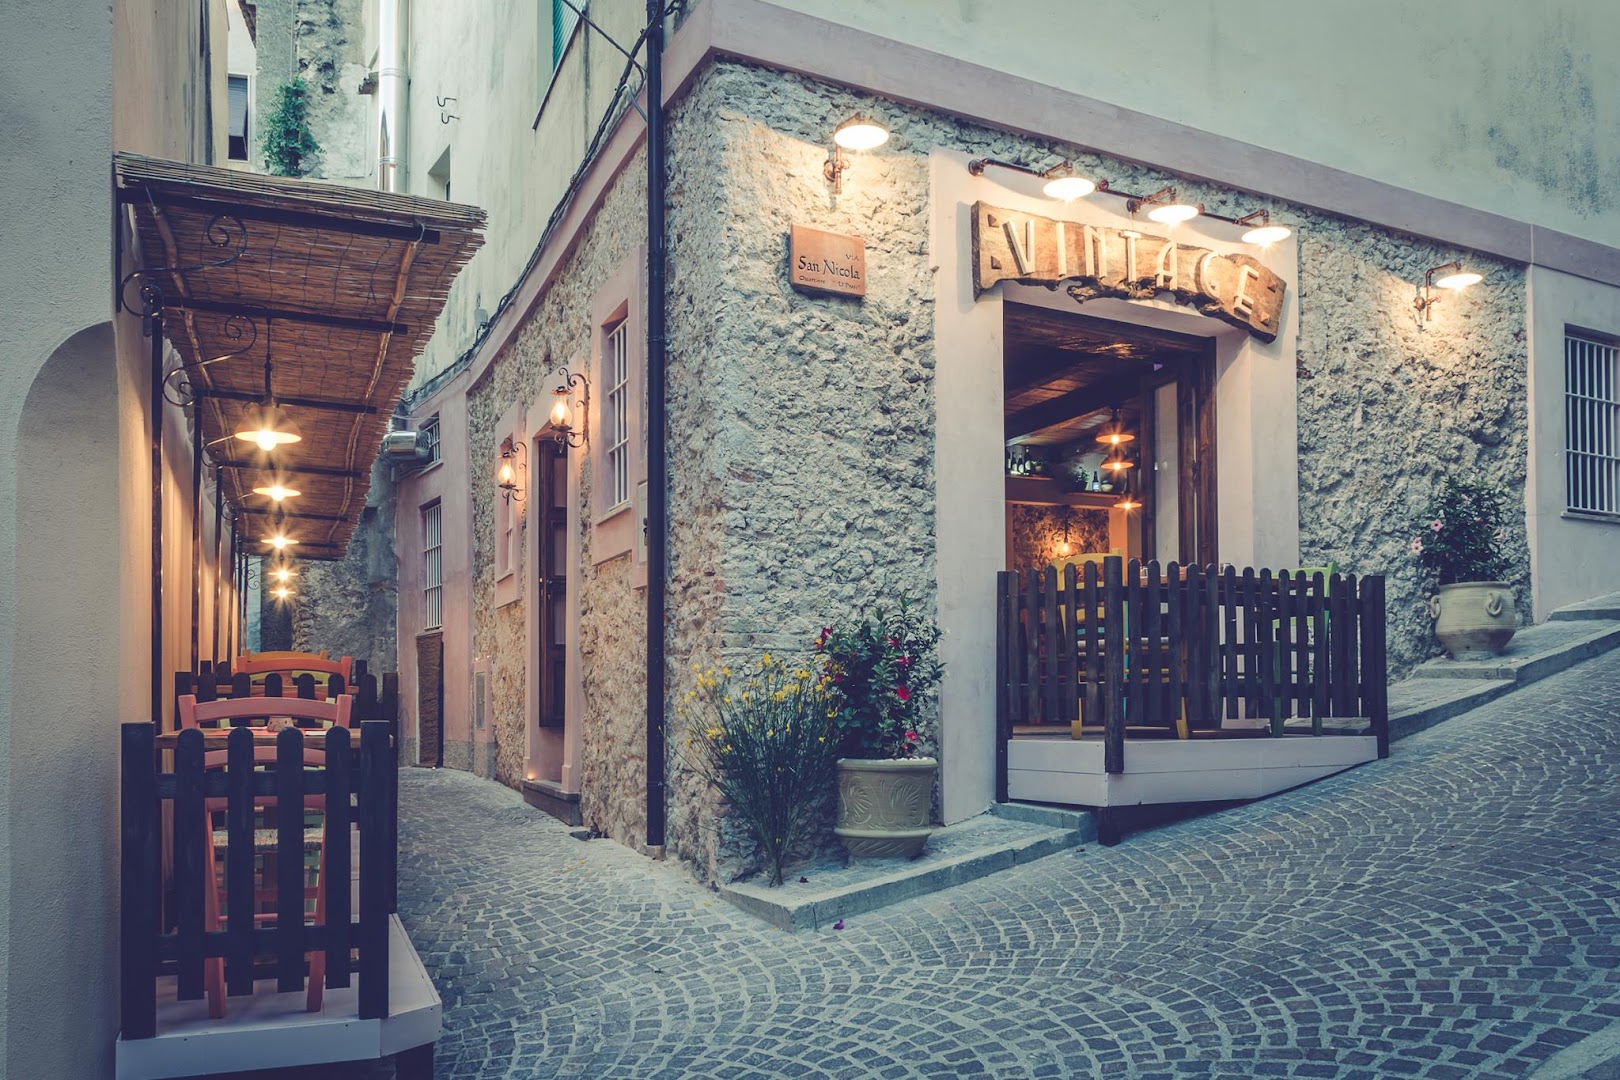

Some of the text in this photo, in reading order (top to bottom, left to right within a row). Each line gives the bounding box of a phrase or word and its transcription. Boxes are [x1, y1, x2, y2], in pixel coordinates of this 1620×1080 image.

[798, 255, 860, 279] San Nicola
[1003, 219, 1259, 315] VINTAGE
